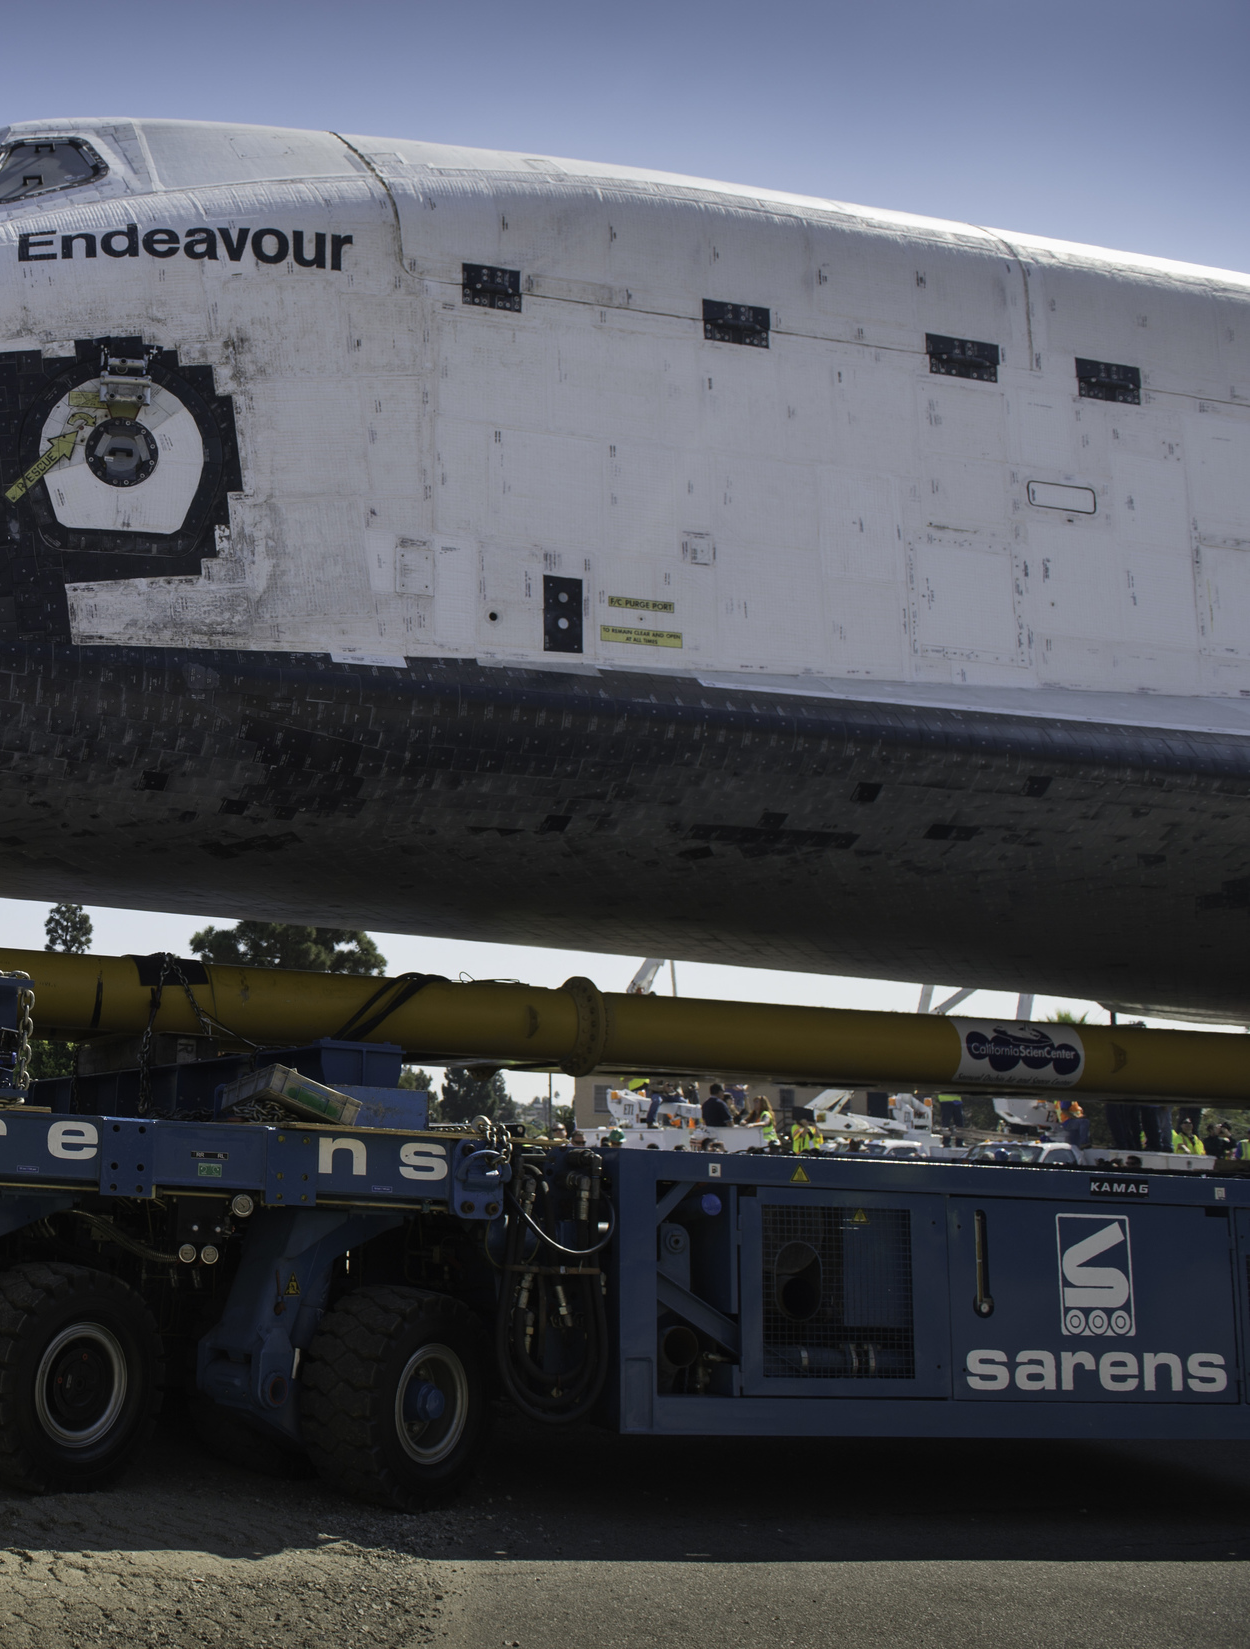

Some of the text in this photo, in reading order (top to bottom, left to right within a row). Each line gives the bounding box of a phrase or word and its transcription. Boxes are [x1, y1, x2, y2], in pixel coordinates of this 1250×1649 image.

[18, 223, 353, 271] Endeavour
[16, 451, 58, 492] RESCUE
[610, 598, 622, 606] F/C
[625, 600, 649, 608] PURGE
[1090, 1180, 1149, 1194] KAMAG
[965, 1349, 1228, 1393] sarens
